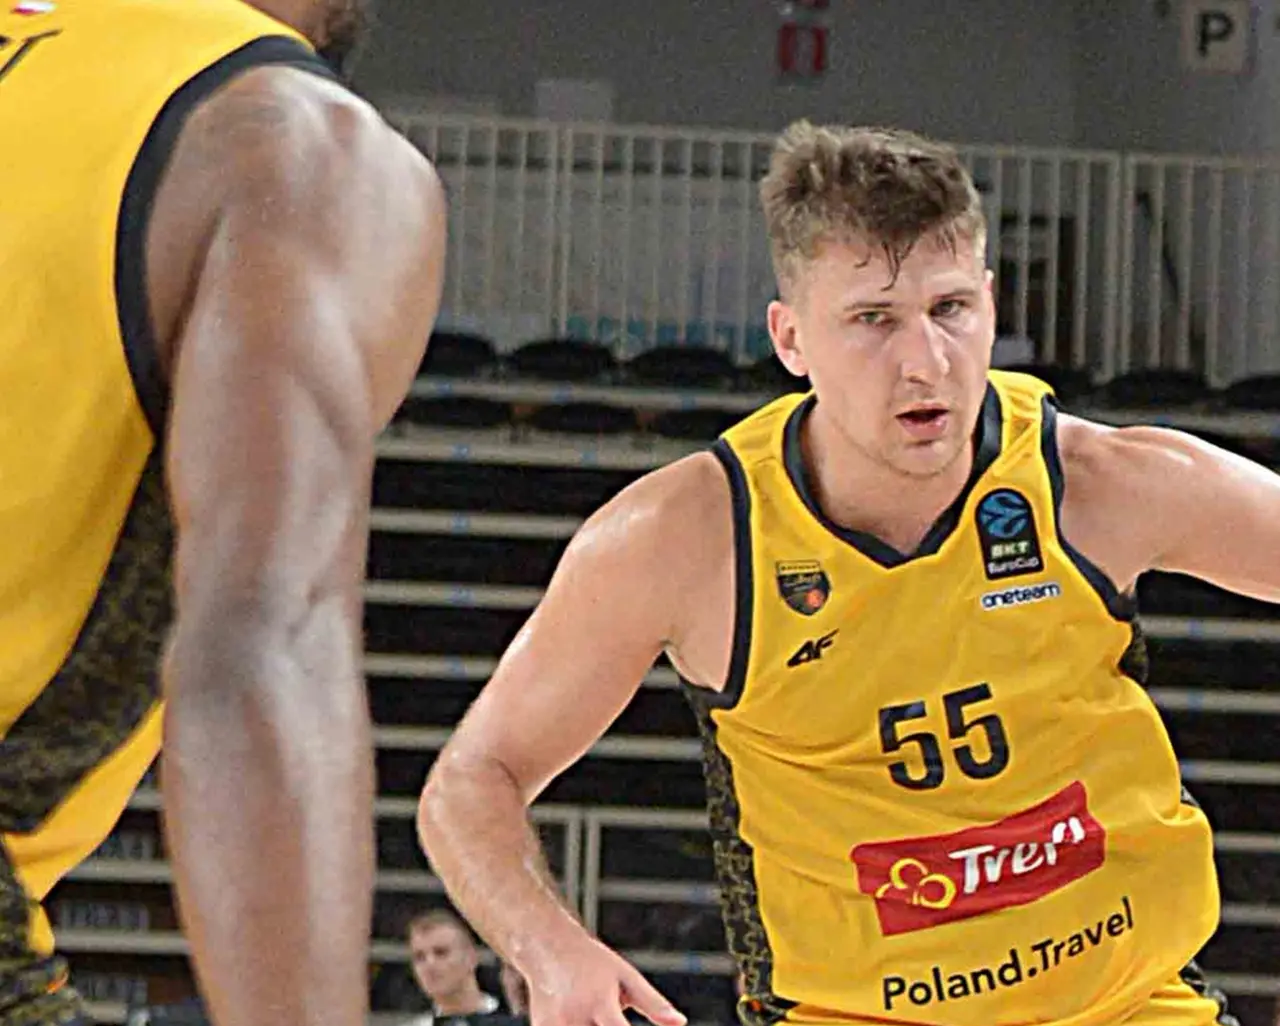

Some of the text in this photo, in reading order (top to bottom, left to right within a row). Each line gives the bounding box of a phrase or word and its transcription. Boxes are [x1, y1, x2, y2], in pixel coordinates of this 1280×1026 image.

[1199, 9, 1234, 57] P
[878, 682, 1010, 791] 55
[882, 895, 1134, 1011] Poland.Travel
